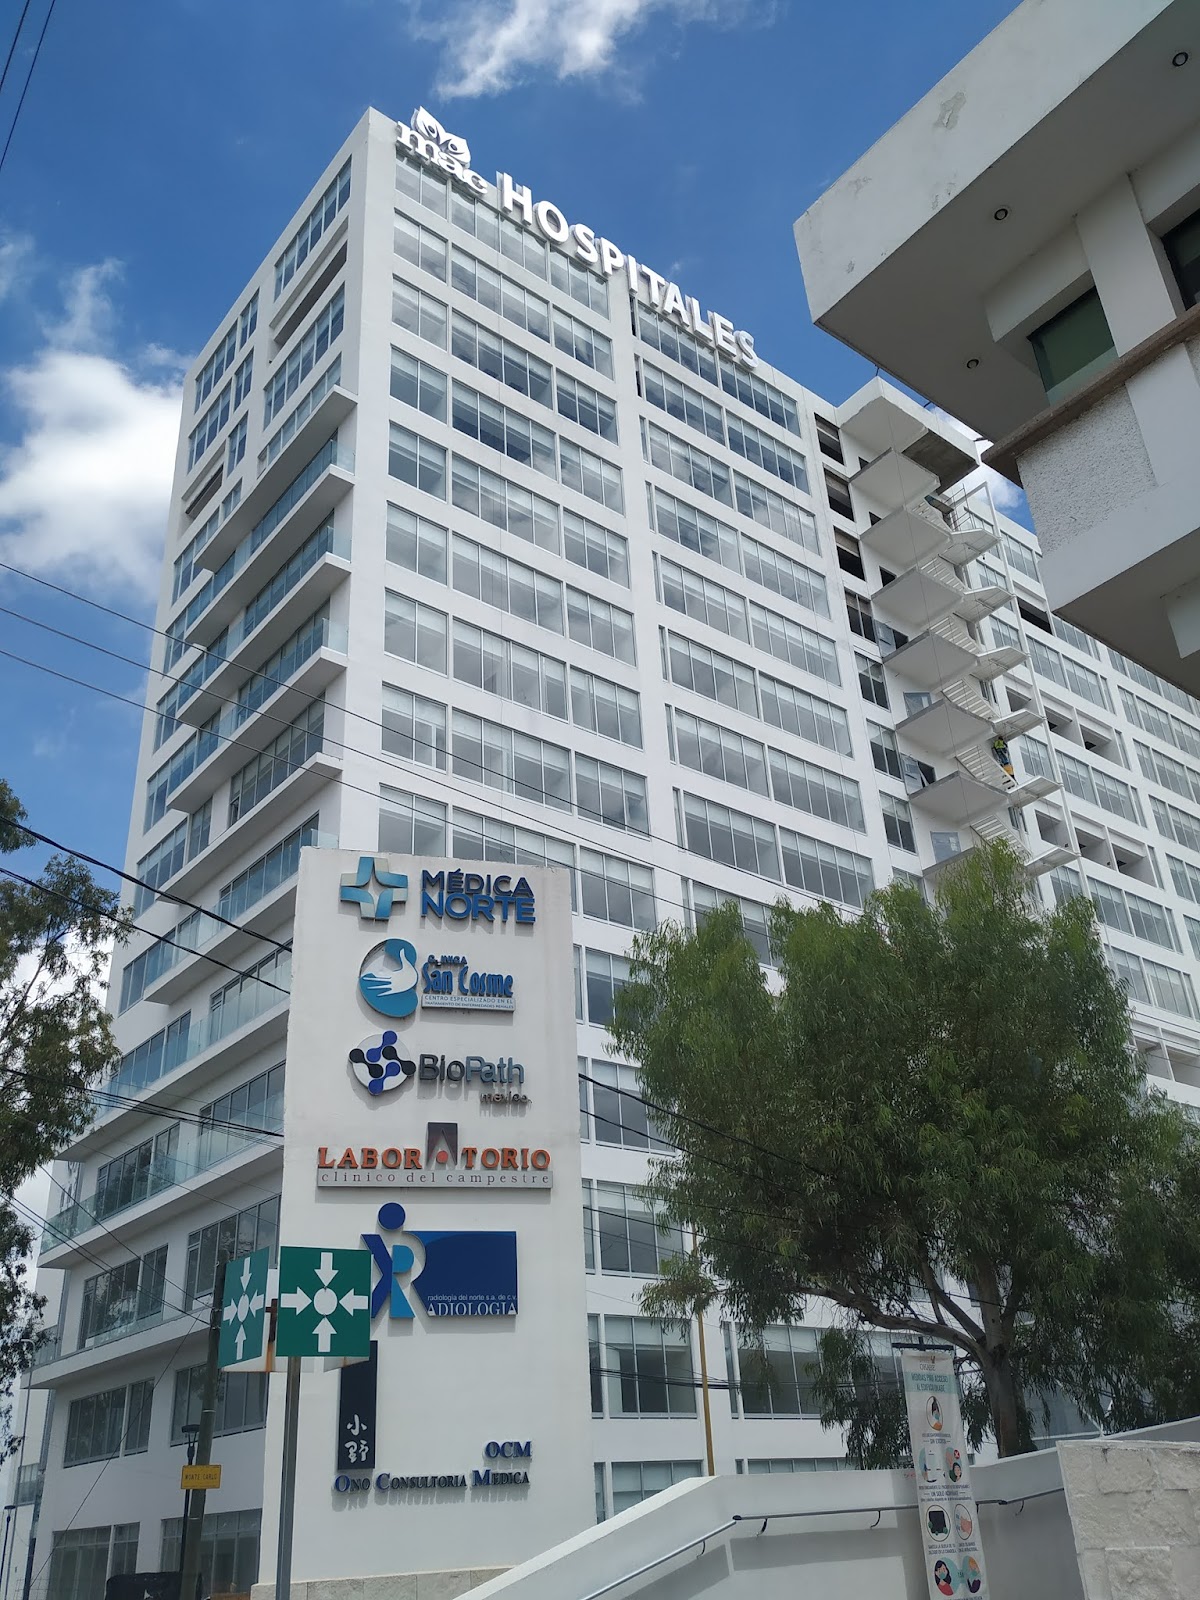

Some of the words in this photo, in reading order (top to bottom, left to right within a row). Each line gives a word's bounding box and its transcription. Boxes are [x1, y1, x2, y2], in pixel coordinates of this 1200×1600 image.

[395, 121, 488, 195] mac
[496, 171, 759, 368] HOSPITALES
[421, 868, 534, 897] MÉDICA
[421, 891, 536, 924] NORTE
[422, 962, 453, 994] San
[459, 965, 514, 997] Cosme
[419, 1053, 524, 1084] BioPath
[318, 1128, 551, 1169] LABORATORIO
[321, 1172, 396, 1182] clinico
[406, 1172, 436, 1183] del
[446, 1172, 549, 1185] campestre
[428, 1294, 457, 1302] radiologia
[485, 1440, 532, 1459] OCM
[334, 1475, 370, 1492] ONO
[376, 1473, 467, 1490] CONSULTORIA
[472, 1469, 530, 1487] MEDICA
